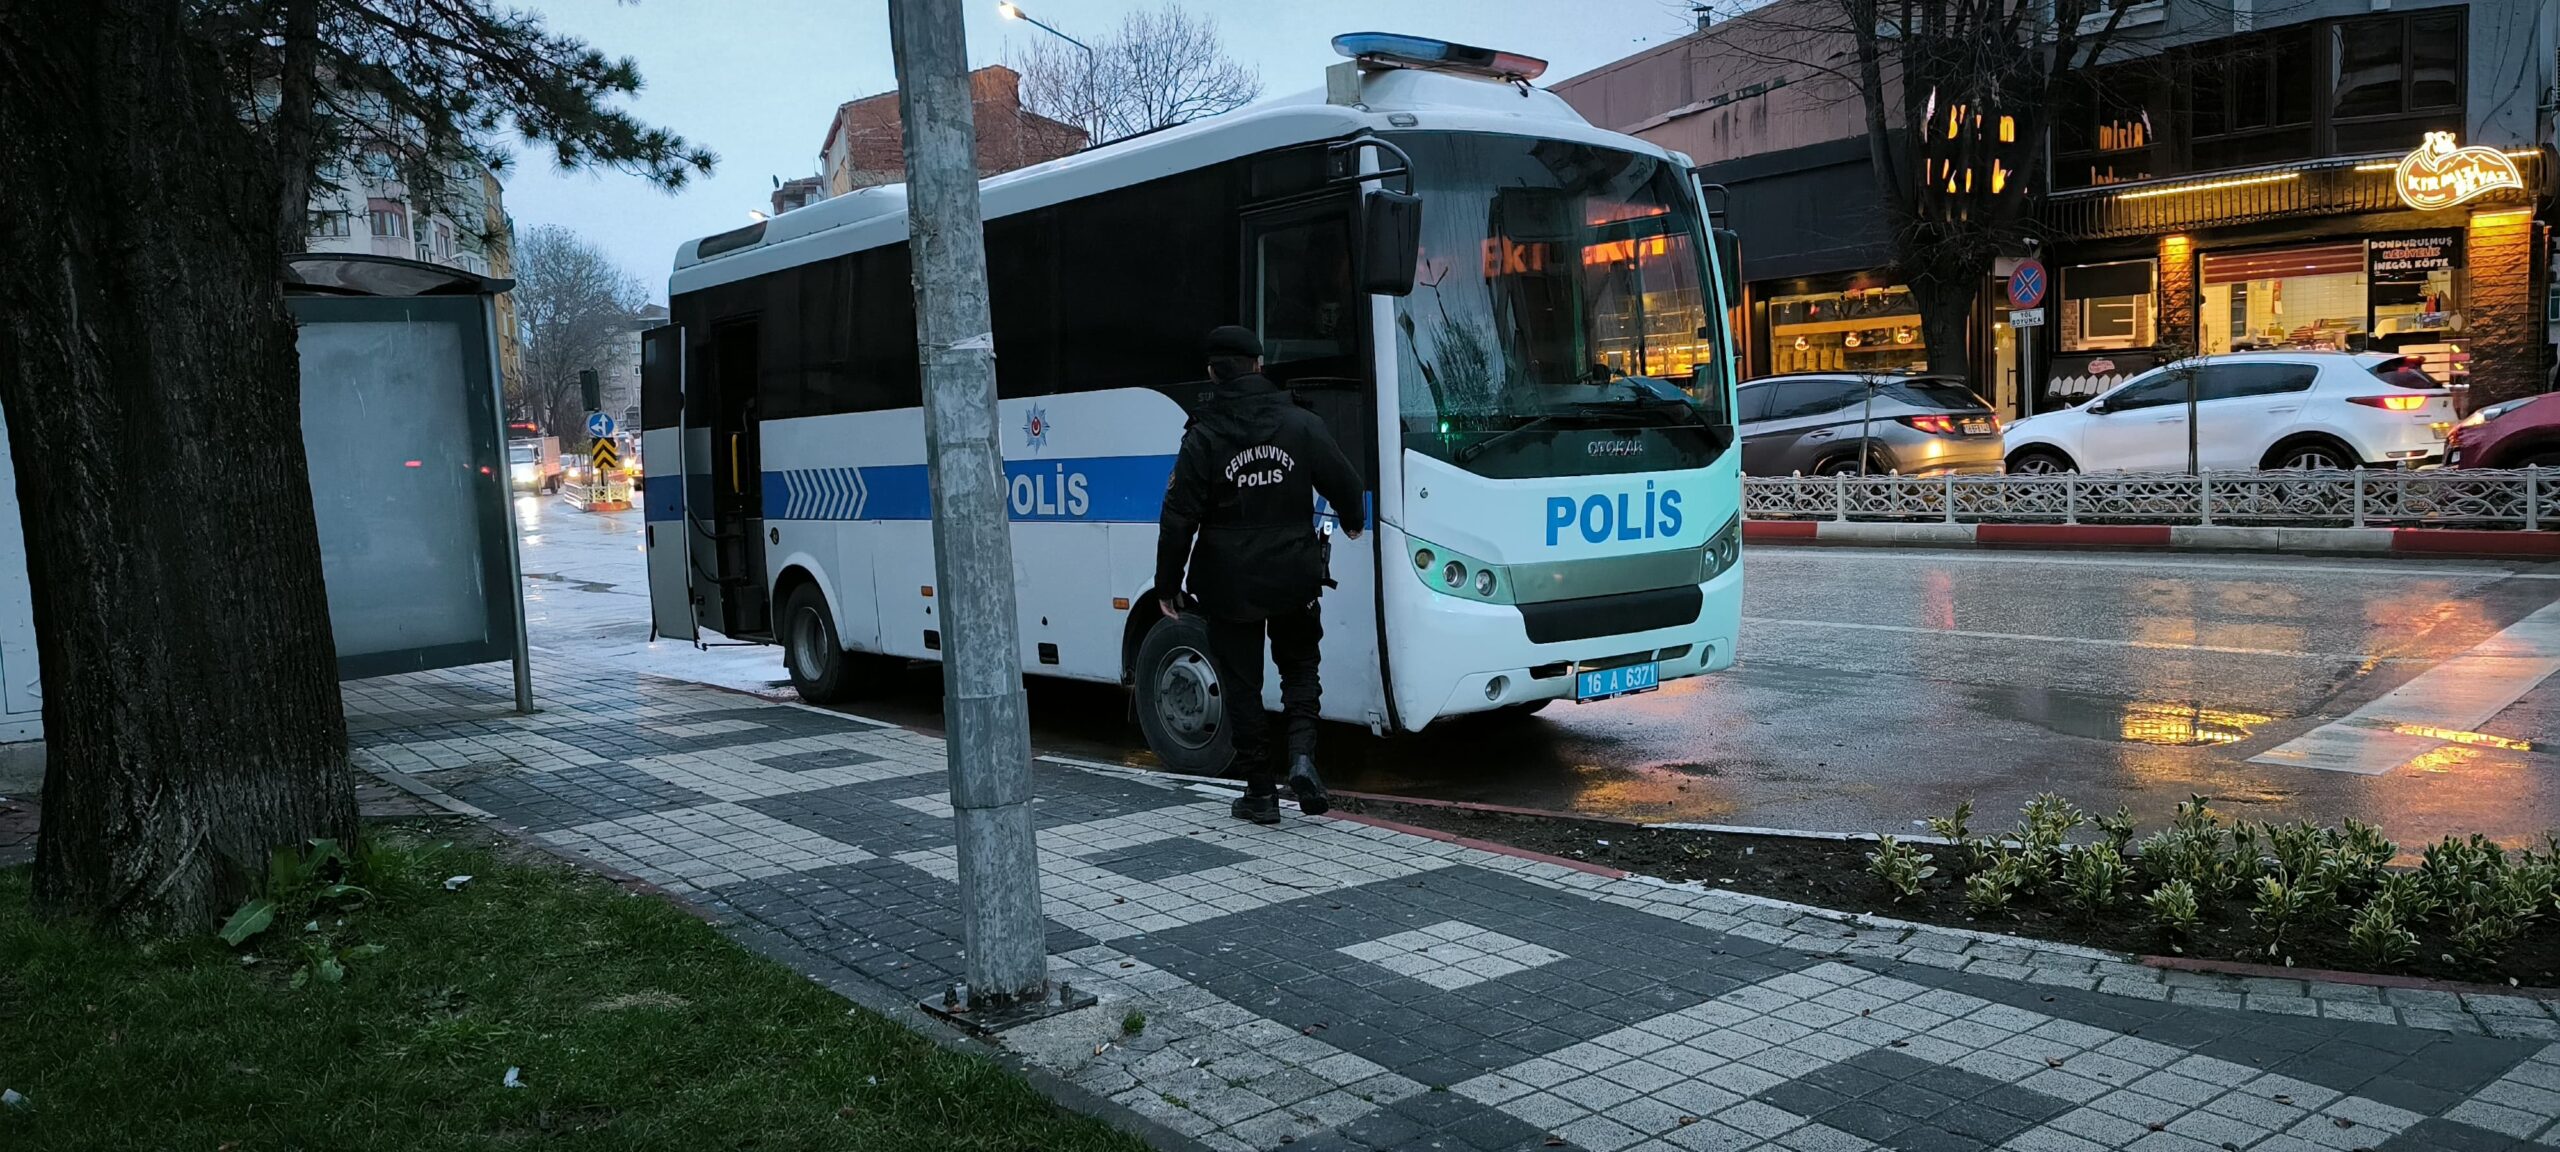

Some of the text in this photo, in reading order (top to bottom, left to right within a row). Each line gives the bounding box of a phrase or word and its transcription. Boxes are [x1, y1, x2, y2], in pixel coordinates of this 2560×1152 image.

[2371, 237, 2453, 249] DONDURULMUŞ
[2373, 257, 2449, 271] İNEGÖL KÖFTE
[1254, 445, 1295, 472] KUVVET
[1587, 439, 1644, 457] OTOKAR
[1545, 479, 1683, 547] POLİS
[1587, 664, 1656, 695] 16 A 6371
